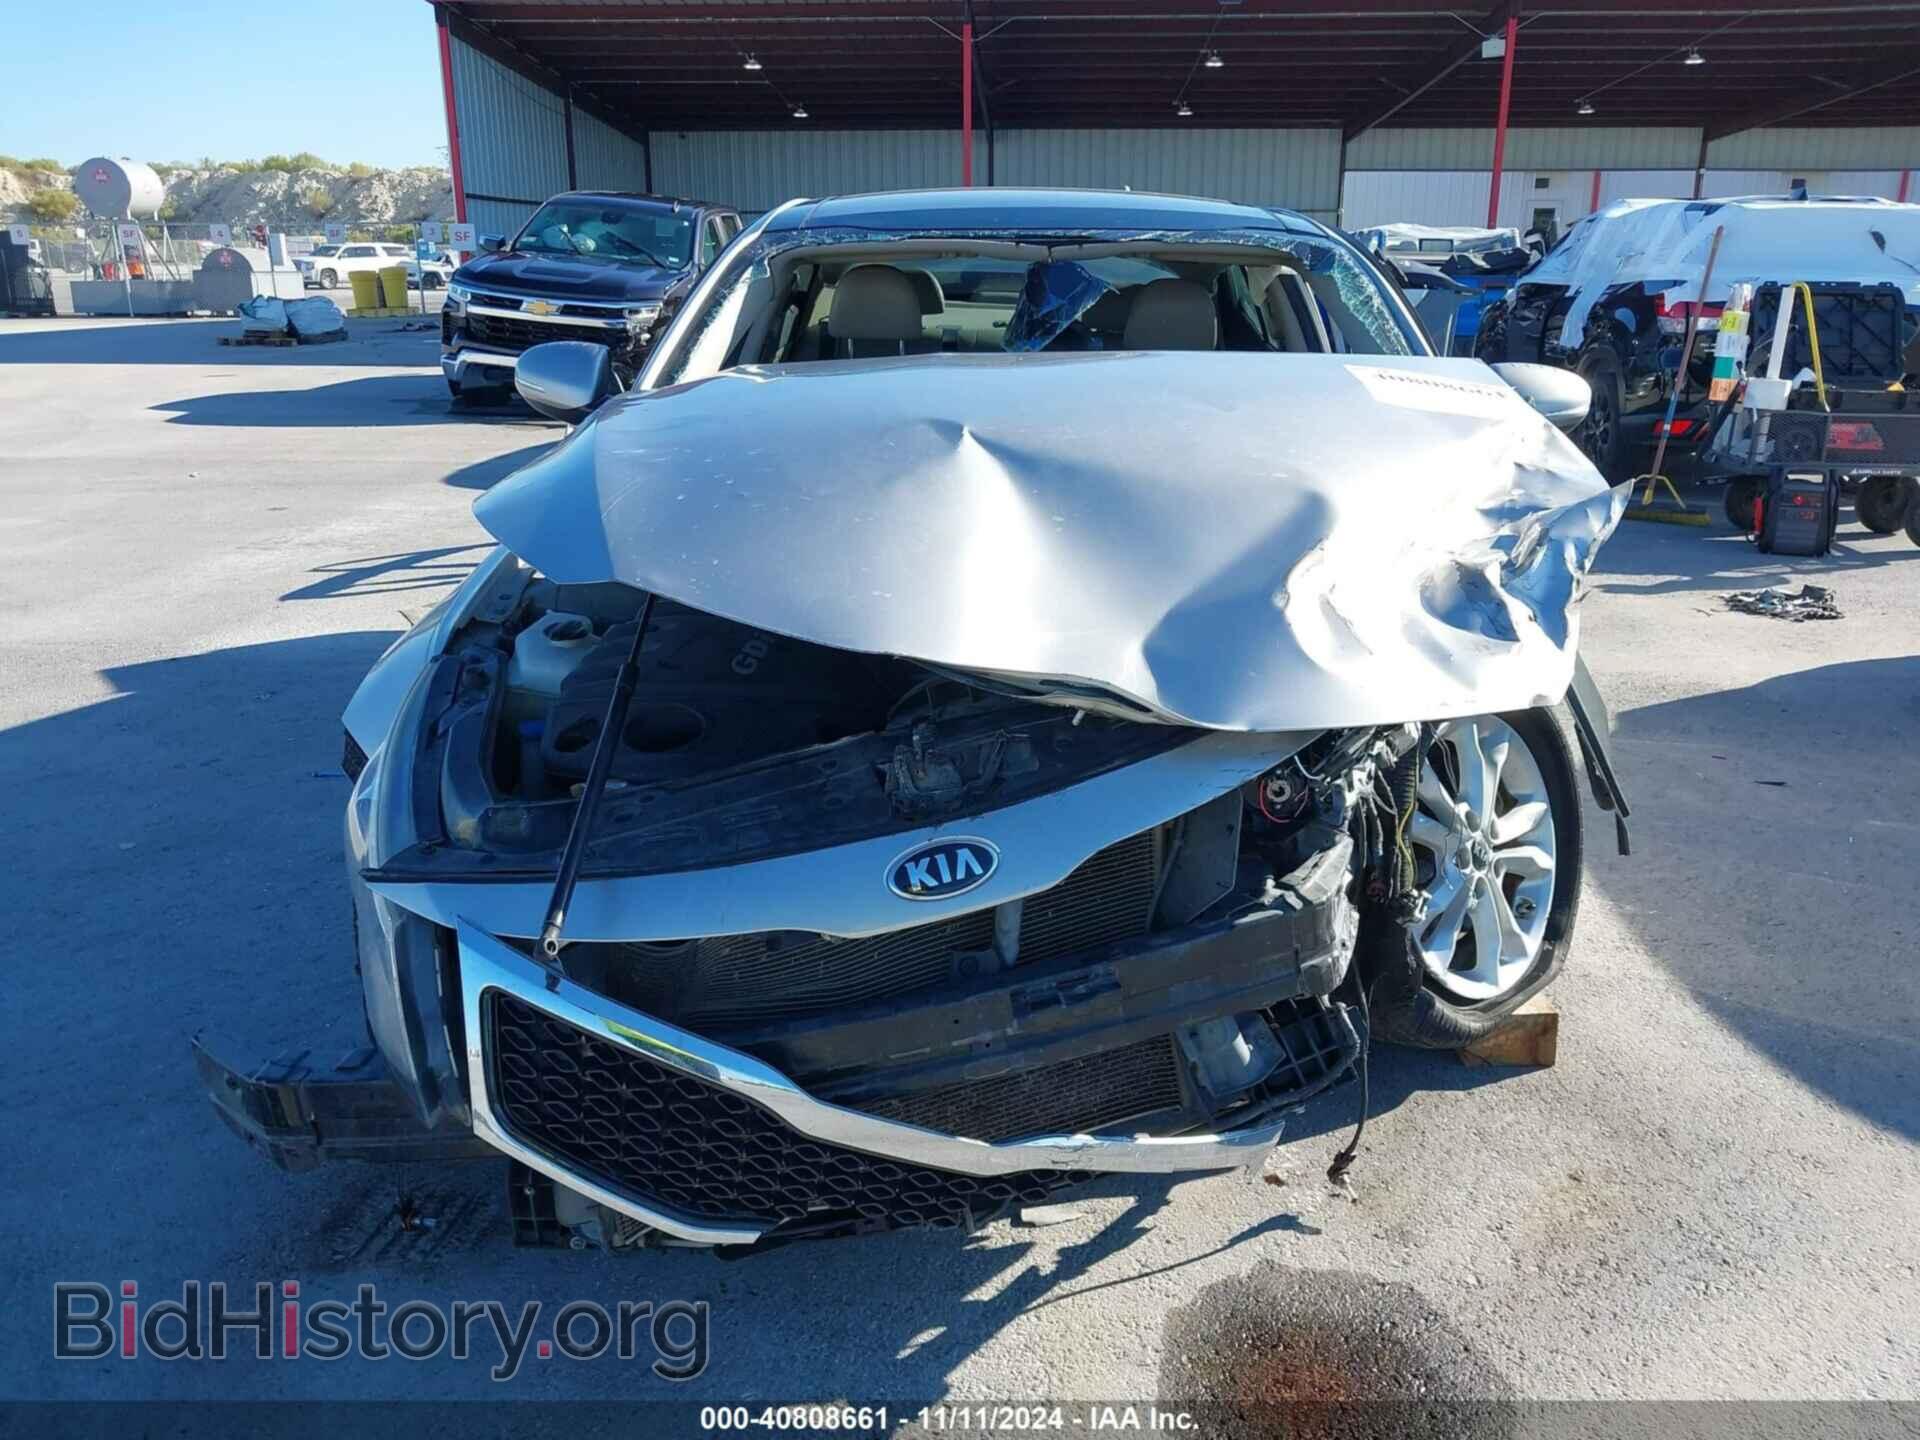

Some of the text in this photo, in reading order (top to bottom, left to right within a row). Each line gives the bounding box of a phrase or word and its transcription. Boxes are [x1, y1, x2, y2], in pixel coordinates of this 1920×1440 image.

[123, 229, 136, 238] SF
[454, 231, 471, 242] SF
[904, 847, 984, 893] KIA
